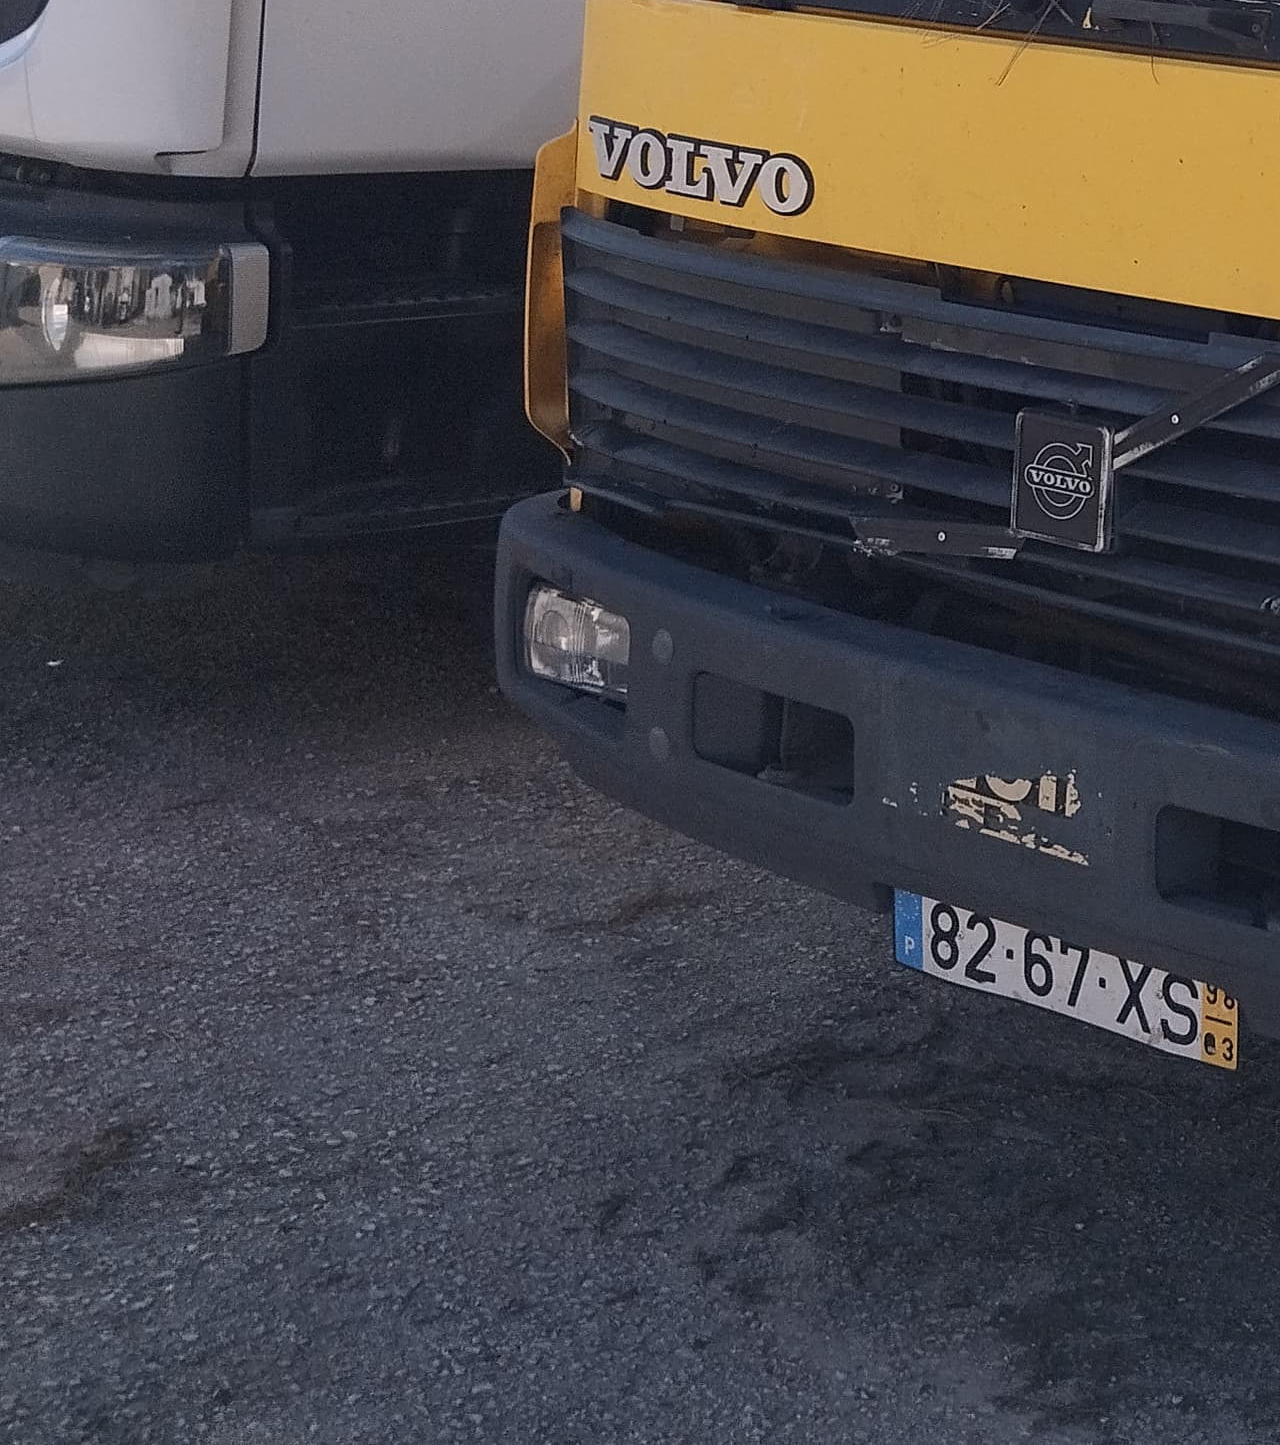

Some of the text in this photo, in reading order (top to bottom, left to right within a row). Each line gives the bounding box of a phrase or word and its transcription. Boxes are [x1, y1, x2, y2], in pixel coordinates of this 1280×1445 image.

[588, 115, 816, 216] VOLVO
[1028, 468, 1092, 494] VOLVO
[904, 935, 915, 954] P
